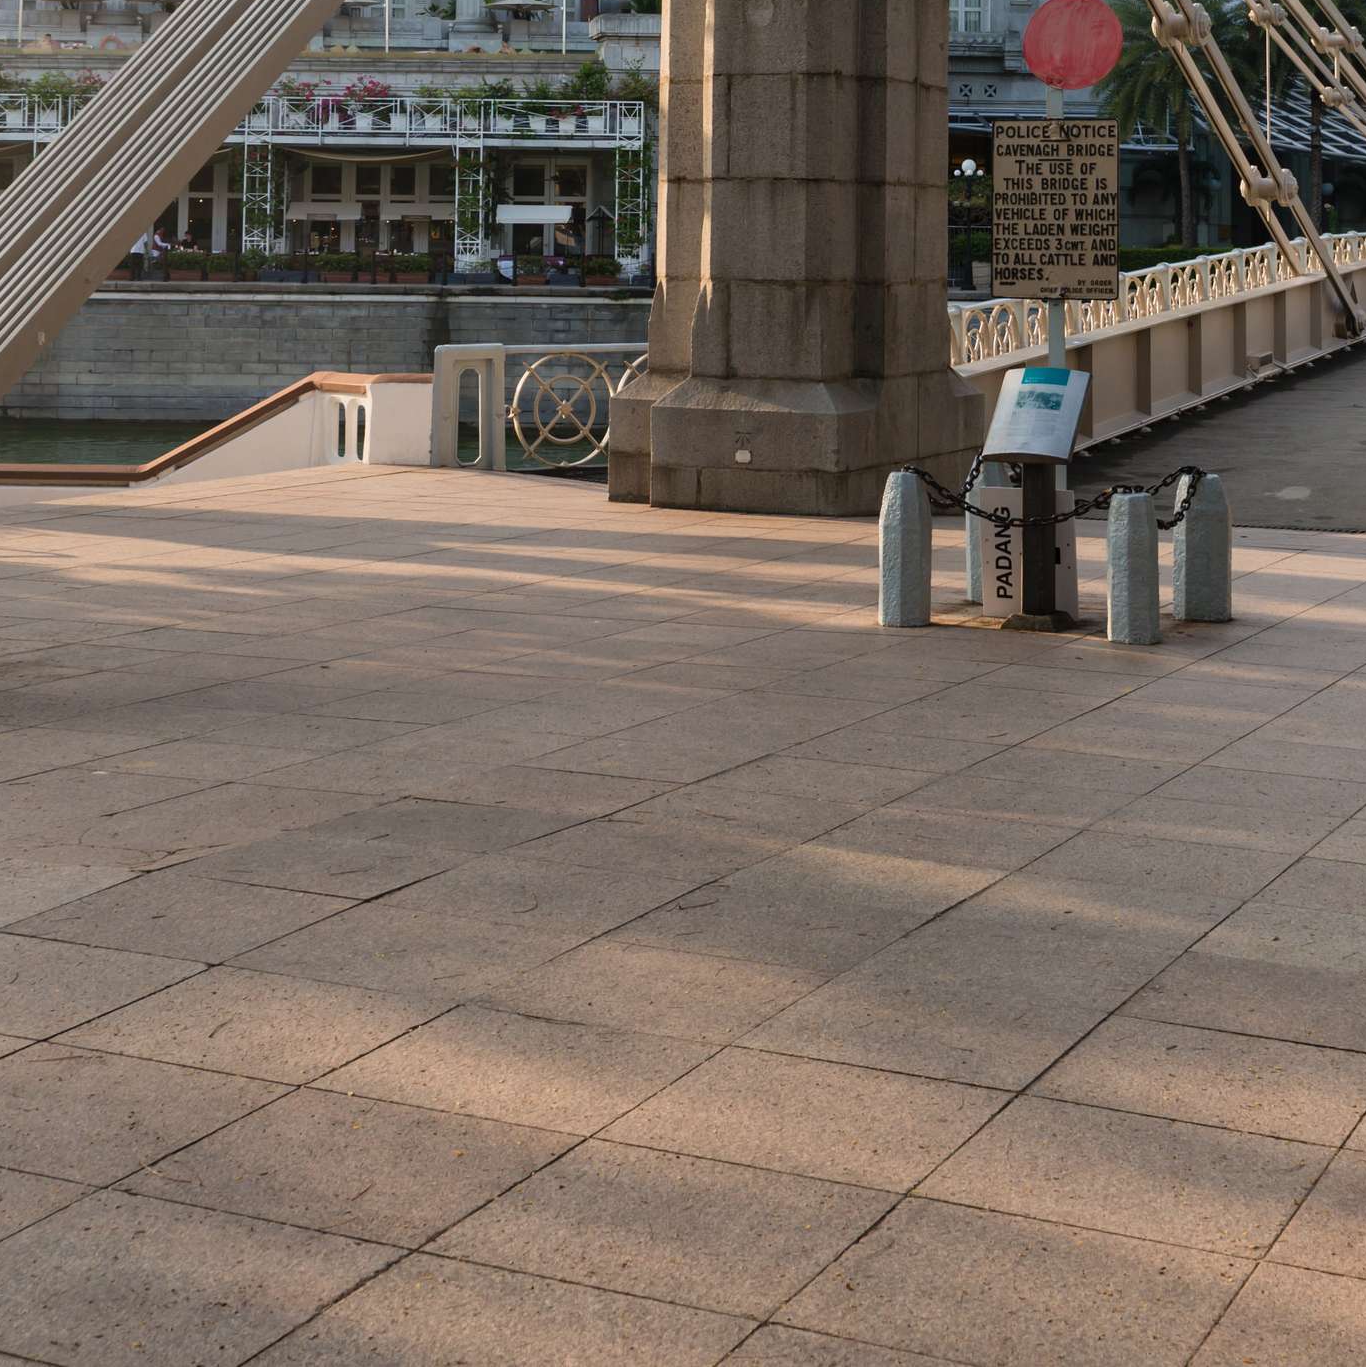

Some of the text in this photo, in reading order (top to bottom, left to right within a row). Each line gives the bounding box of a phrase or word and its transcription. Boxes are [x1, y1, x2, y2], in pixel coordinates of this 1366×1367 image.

[996, 124, 1116, 139] POLICE NOTICE
[996, 144, 1114, 157] CAVENAGH BRIDGE
[1015, 160, 1097, 175] THE USE OF
[1003, 178, 1107, 191] THIS BRIDGE IS
[994, 192, 1117, 206] PROHIBITED TO ANY
[995, 208, 1115, 221] VEHICLE OF WHICH
[994, 223, 1118, 236] THE LADEN WEIGHT
[994, 238, 1050, 251] EXCEEDS
[1090, 239, 1116, 251] AND
[993, 253, 1117, 266] TO ALL CATTLE AND
[994, 268, 1050, 281] HORSES.
[994, 506, 1013, 600] PADANG
